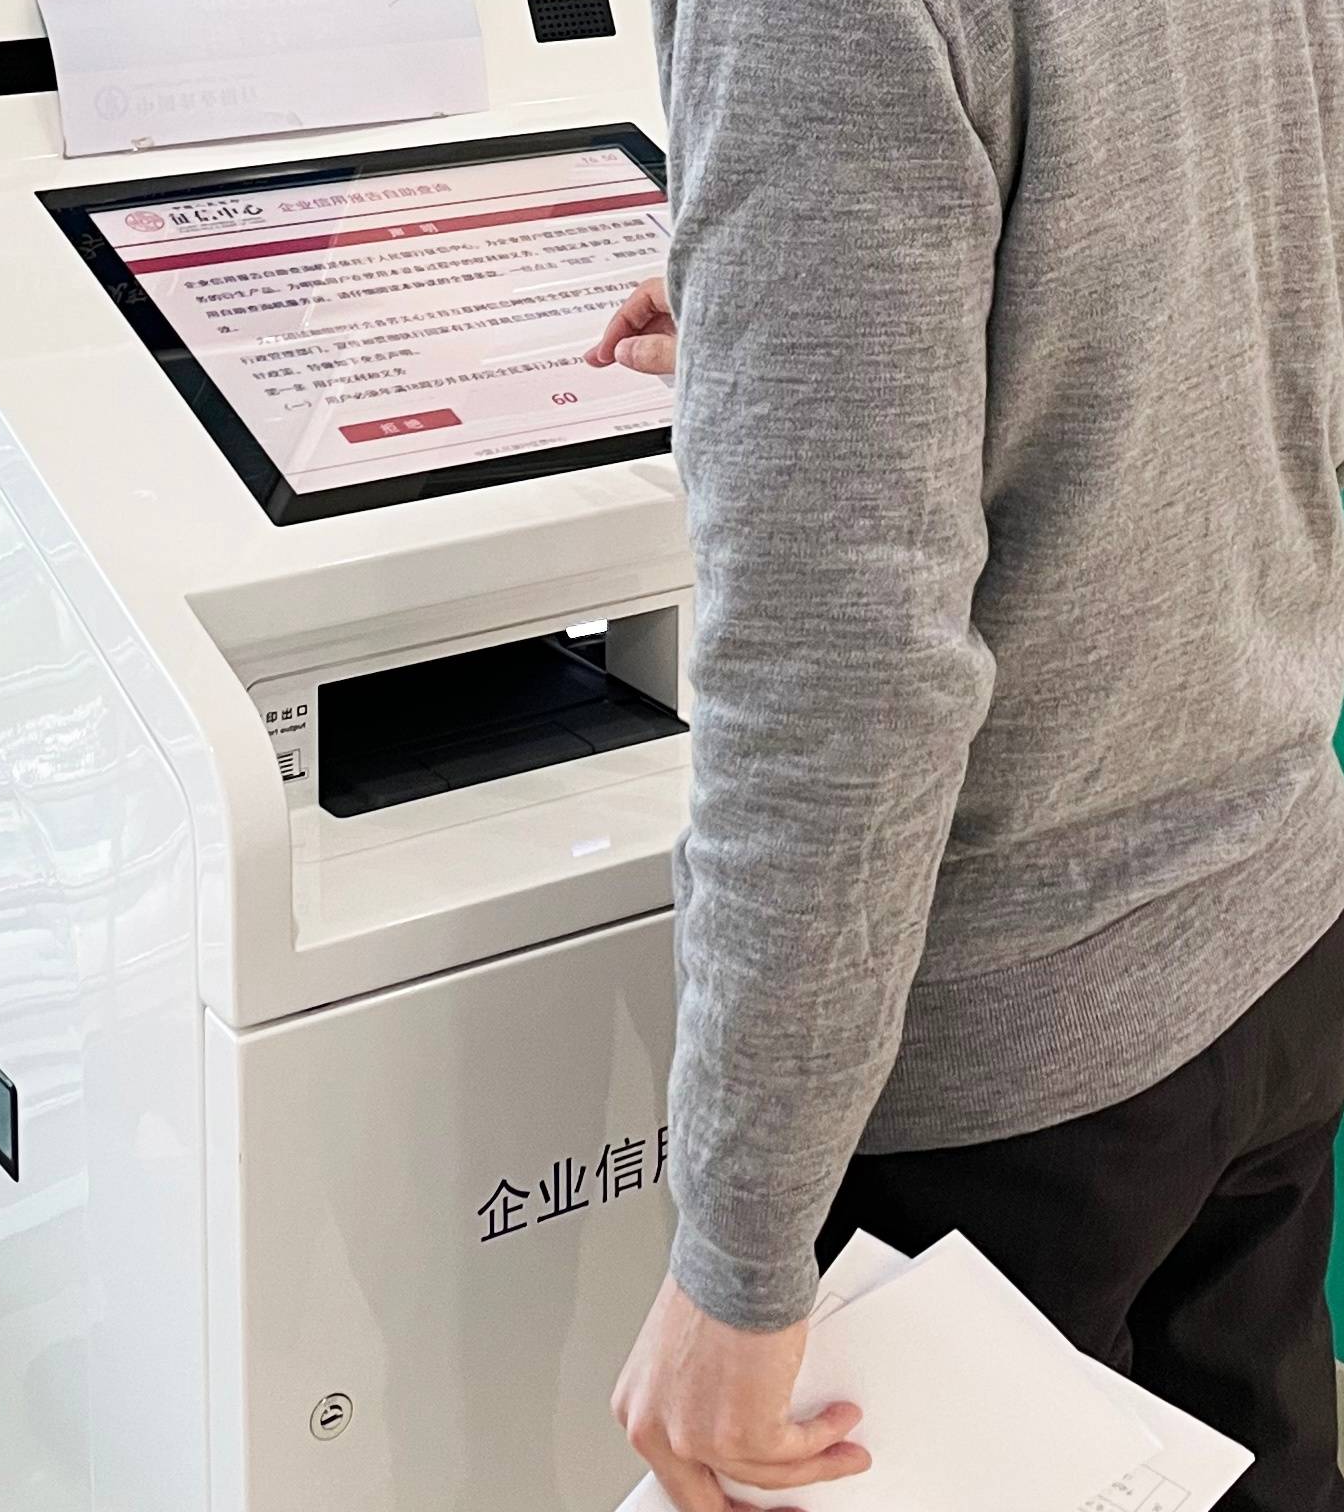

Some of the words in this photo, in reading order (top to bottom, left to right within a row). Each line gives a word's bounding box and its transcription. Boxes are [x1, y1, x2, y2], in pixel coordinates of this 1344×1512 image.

[276, 184, 453, 213] 企业信用报告自助查询
[551, 390, 580, 407] 60
